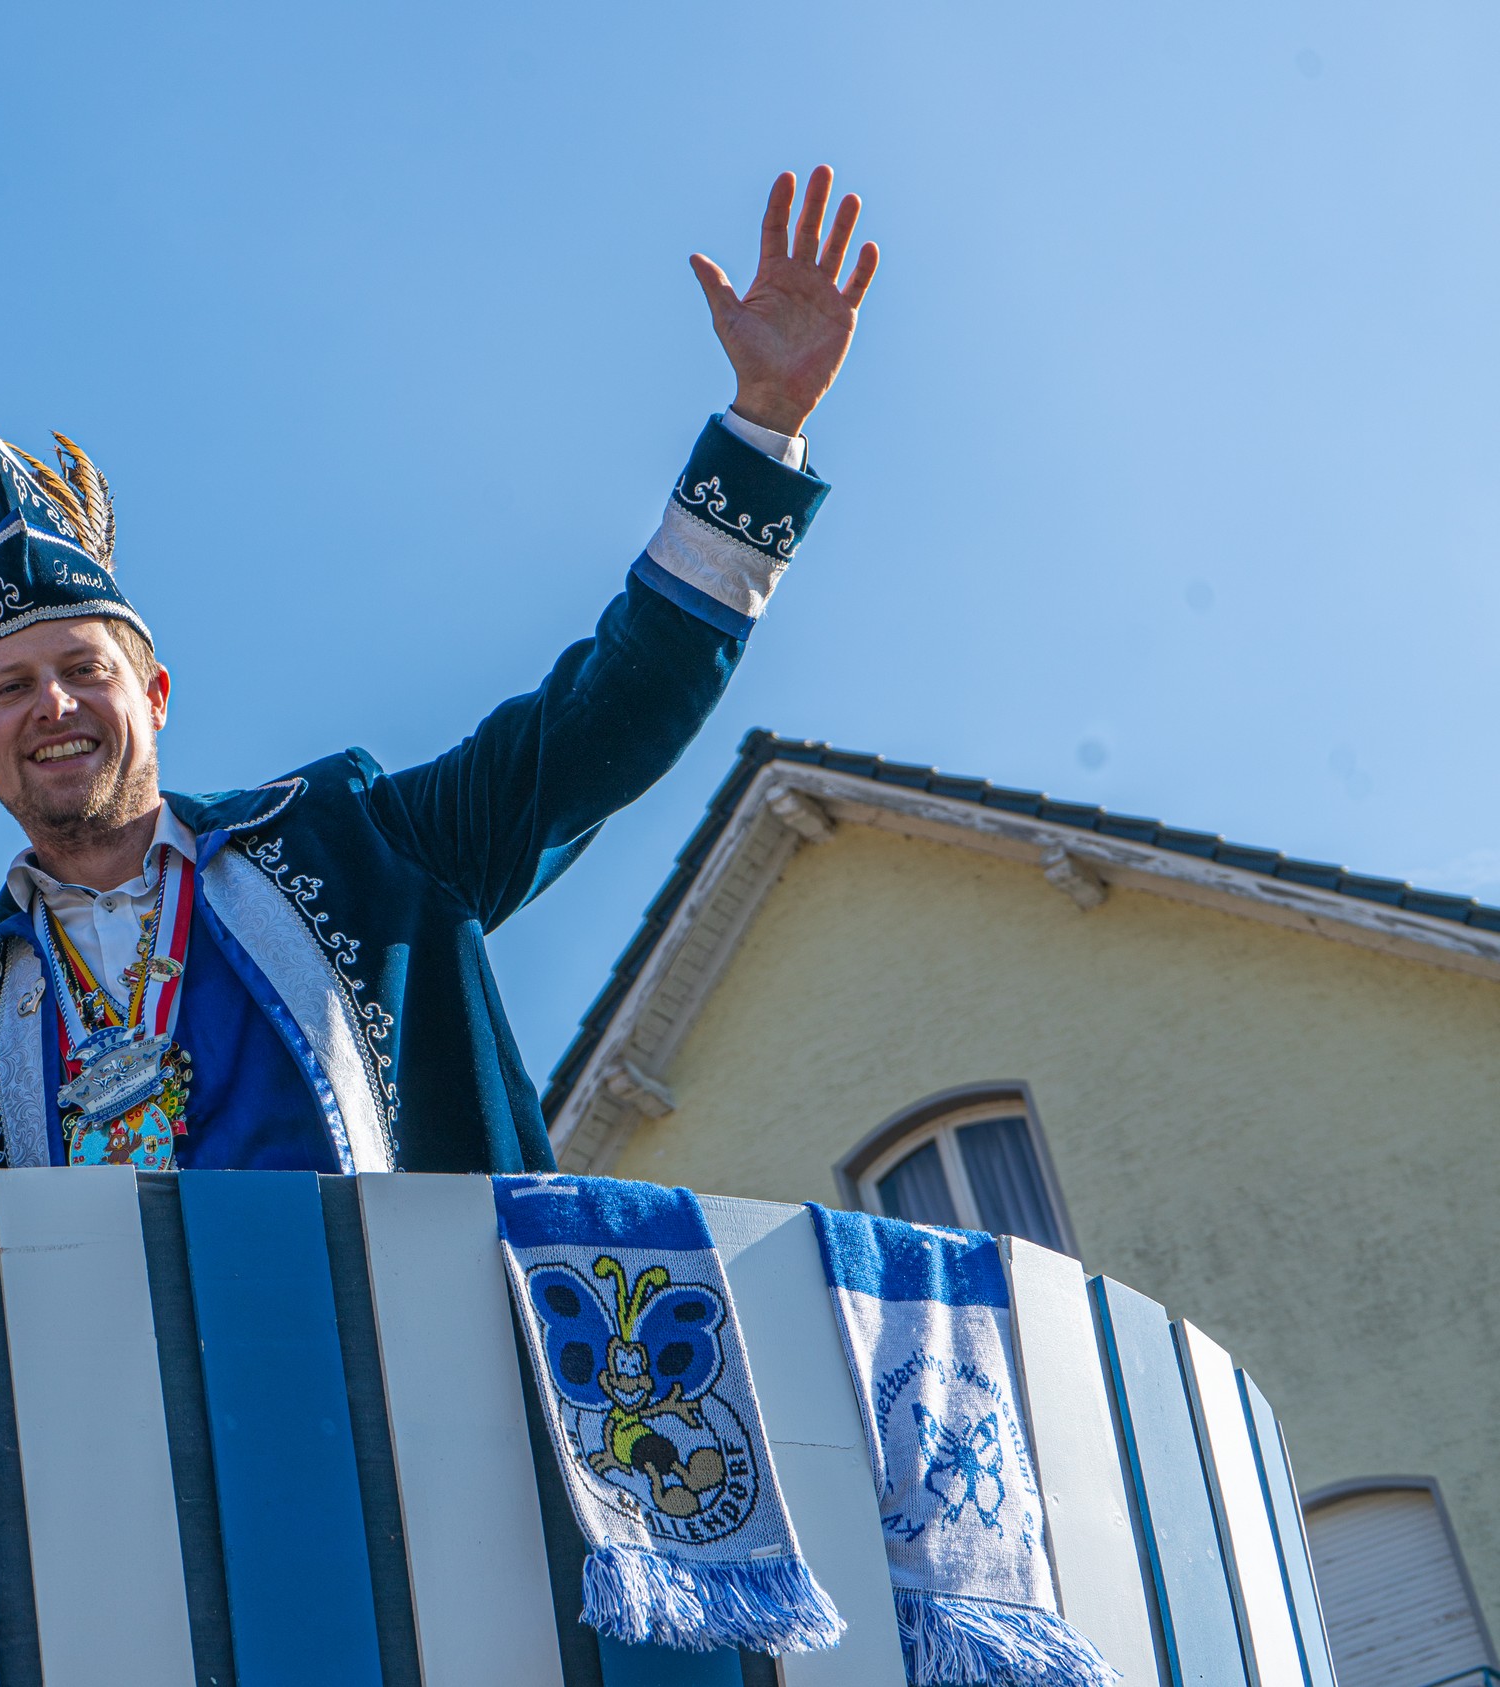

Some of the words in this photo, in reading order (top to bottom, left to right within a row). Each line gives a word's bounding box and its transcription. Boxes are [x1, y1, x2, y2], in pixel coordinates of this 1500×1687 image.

[53, 559, 107, 591] Daniel
[138, 1038, 155, 1049] 2022
[70, 1074, 86, 1089] 2021
[94, 1087, 115, 1103] PRINZ
[116, 1072, 142, 1088] DANIEL
[127, 1109, 142, 1122] 50
